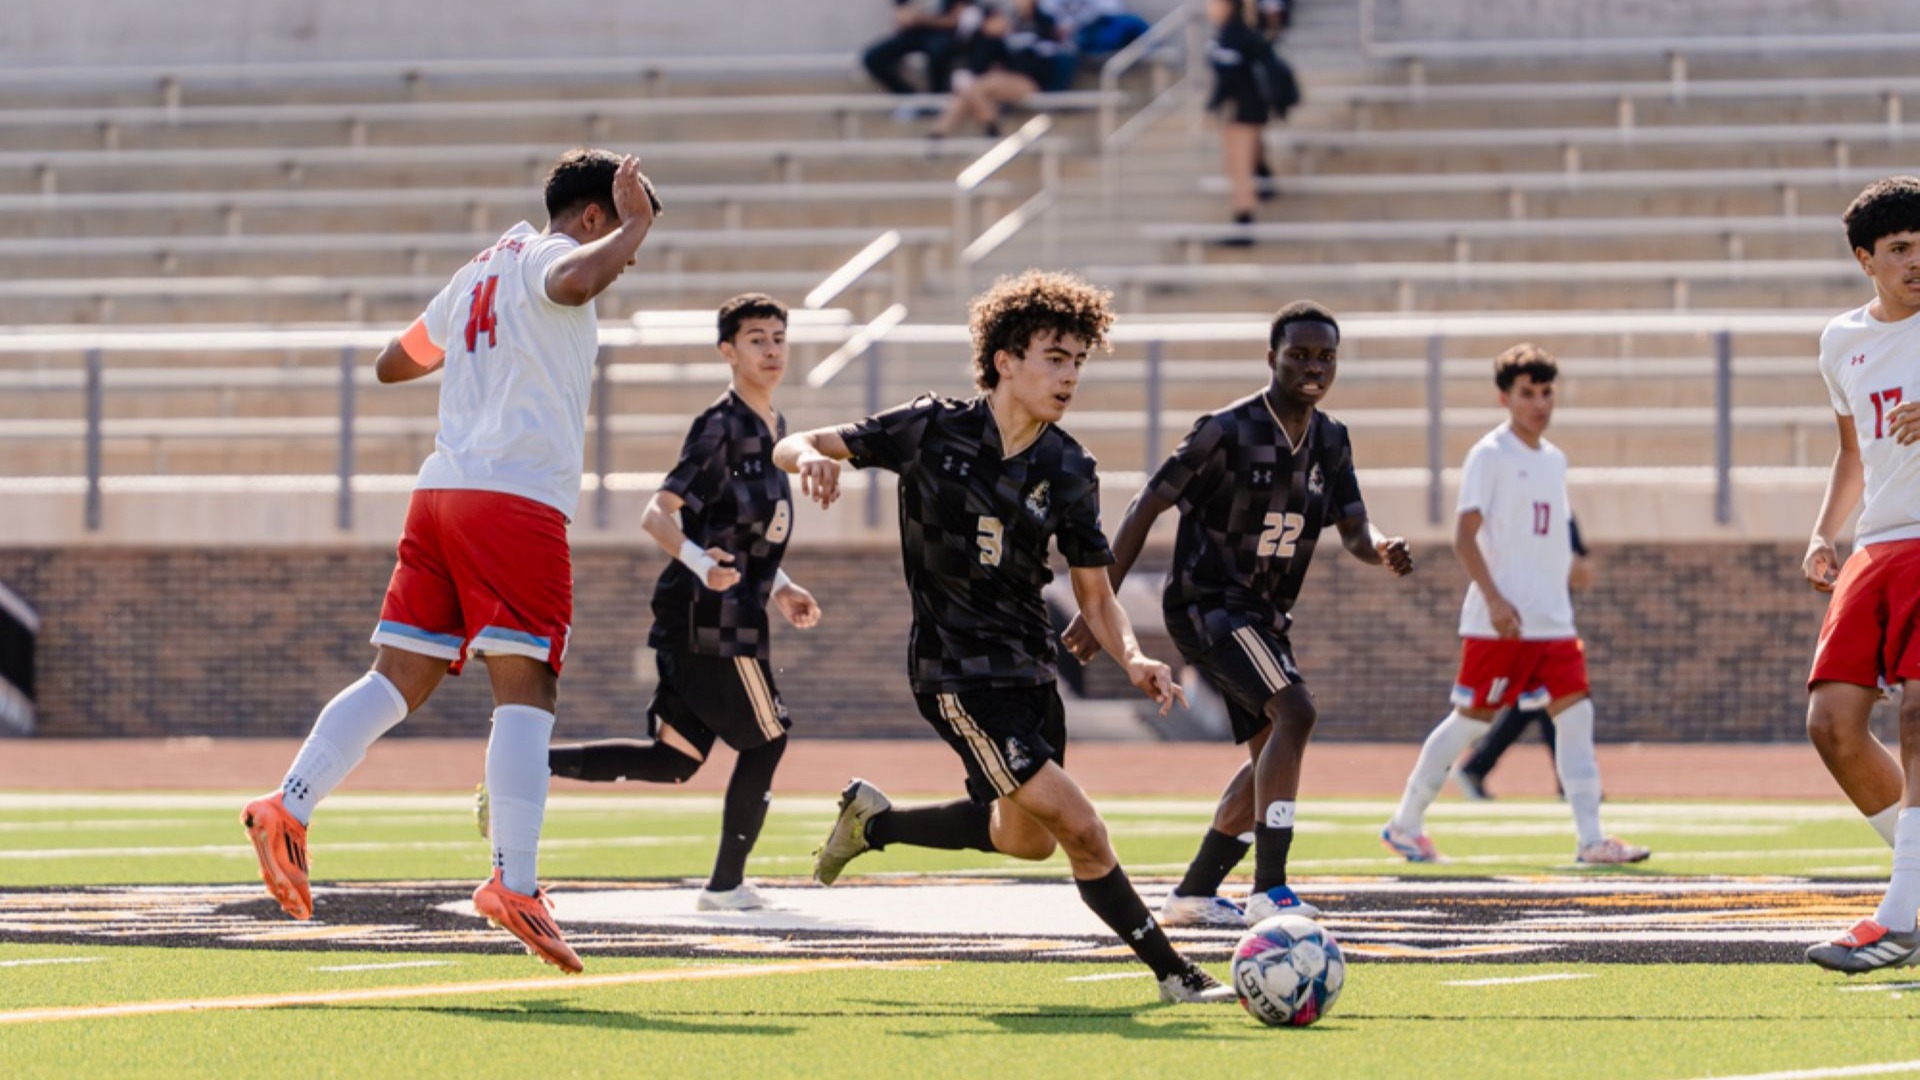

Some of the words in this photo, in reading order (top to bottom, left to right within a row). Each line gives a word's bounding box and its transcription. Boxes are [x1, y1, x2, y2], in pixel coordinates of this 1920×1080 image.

[464, 273, 500, 354] 14
[765, 499, 790, 543] 8
[976, 514, 1004, 568] 3
[1256, 511, 1305, 558] 22
[1240, 967, 1287, 1020] SELECT
